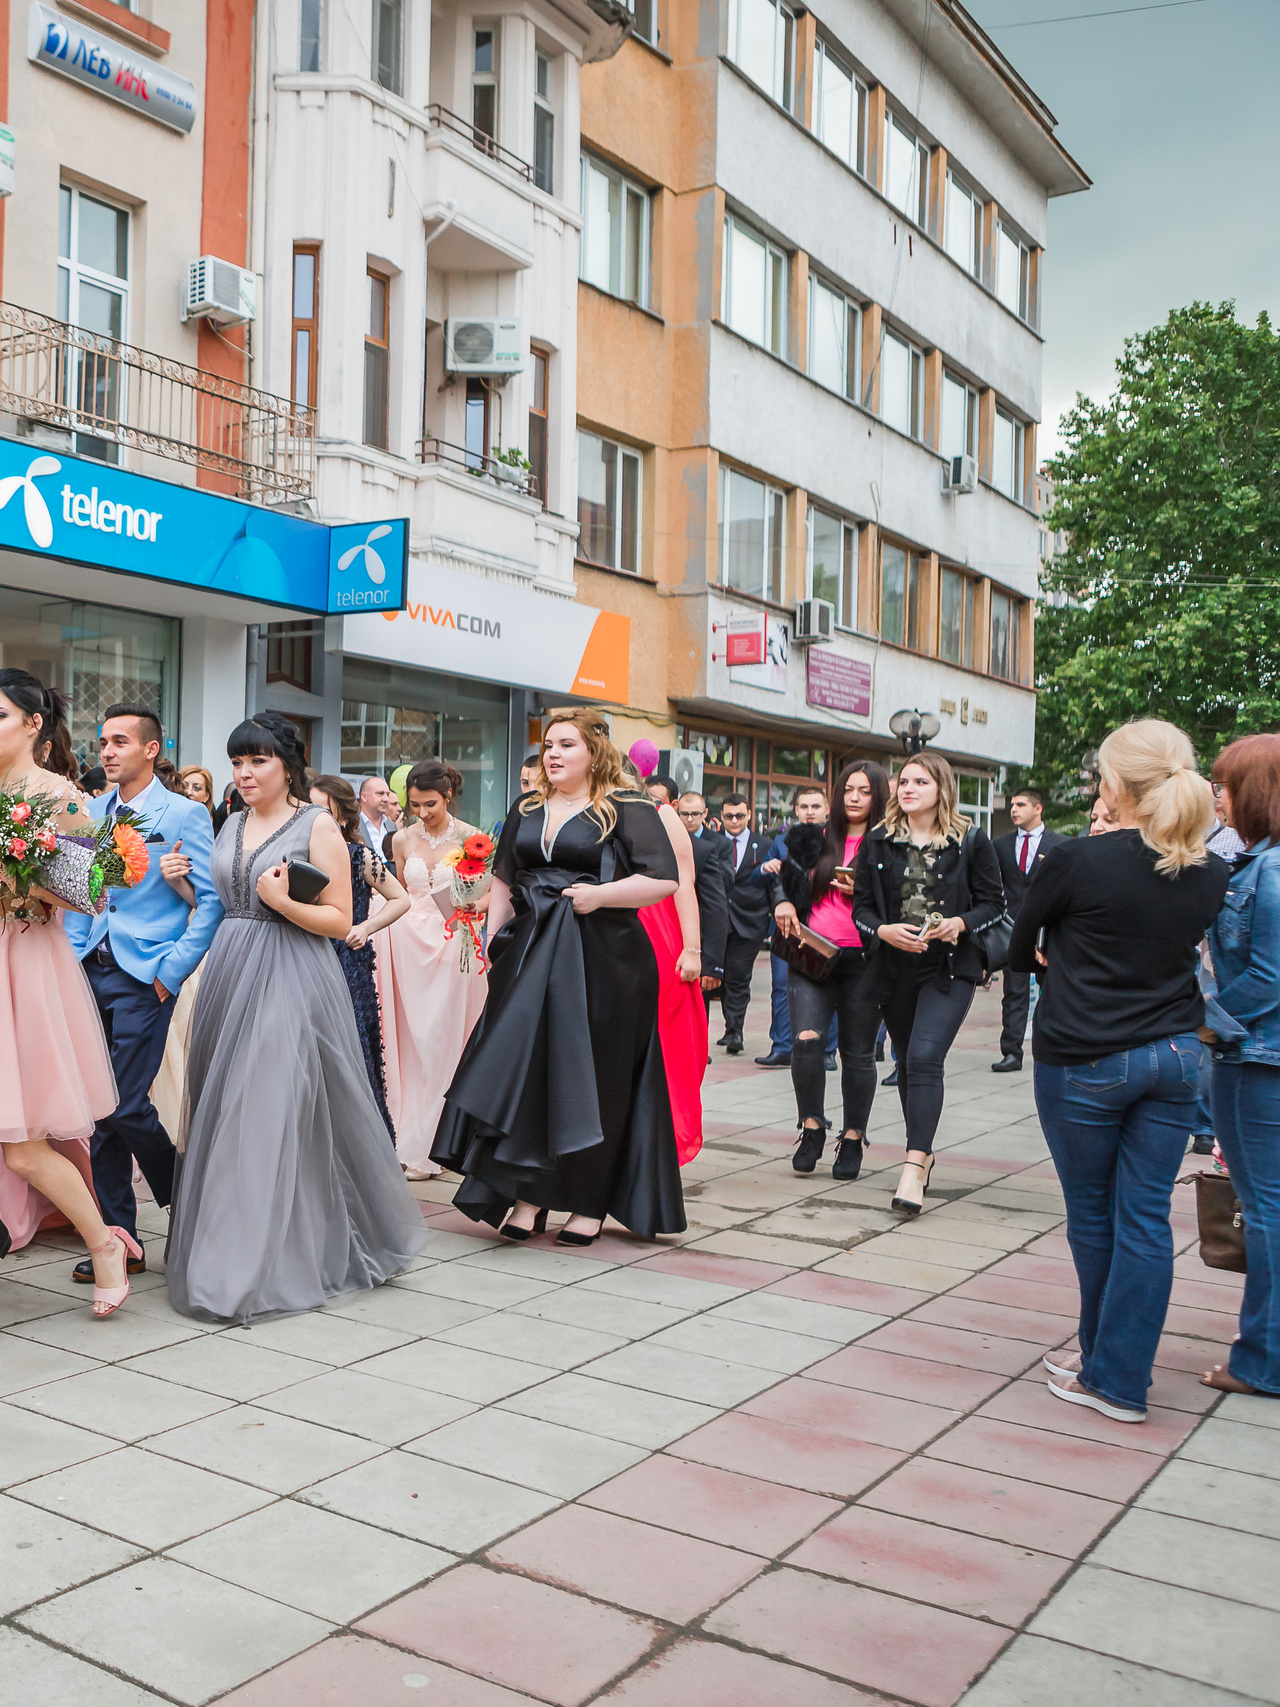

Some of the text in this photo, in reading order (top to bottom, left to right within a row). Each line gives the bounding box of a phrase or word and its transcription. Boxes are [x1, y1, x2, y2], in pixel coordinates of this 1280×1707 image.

[61, 482, 163, 542] telenor
[337, 588, 390, 607] telenor
[407, 601, 501, 639] VIVACOM
